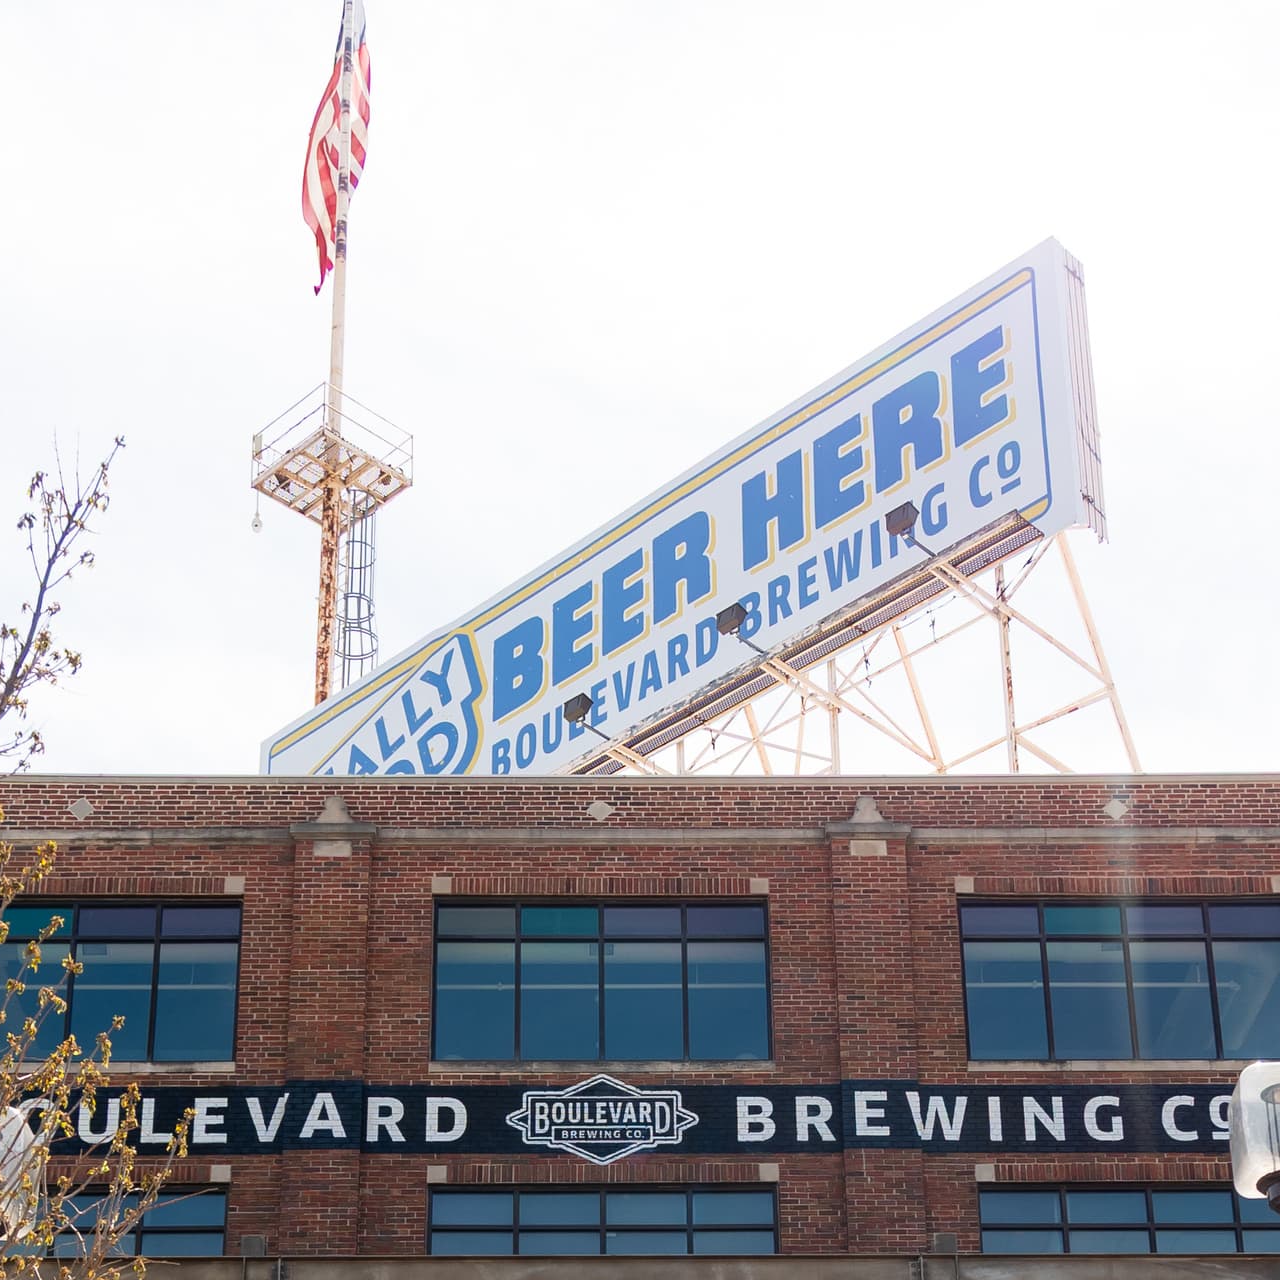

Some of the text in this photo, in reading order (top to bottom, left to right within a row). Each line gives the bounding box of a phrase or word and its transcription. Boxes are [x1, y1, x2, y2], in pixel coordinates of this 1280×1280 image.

[492, 324, 1014, 723] BEER HERE
[347, 647, 455, 775] ALLY
[17, 1091, 468, 1144] OULEVARD
[736, 1090, 1124, 1143] BREWING
[534, 1101, 671, 1134] BOULEVARD
[561, 1129, 645, 1139] BREWING CO.
